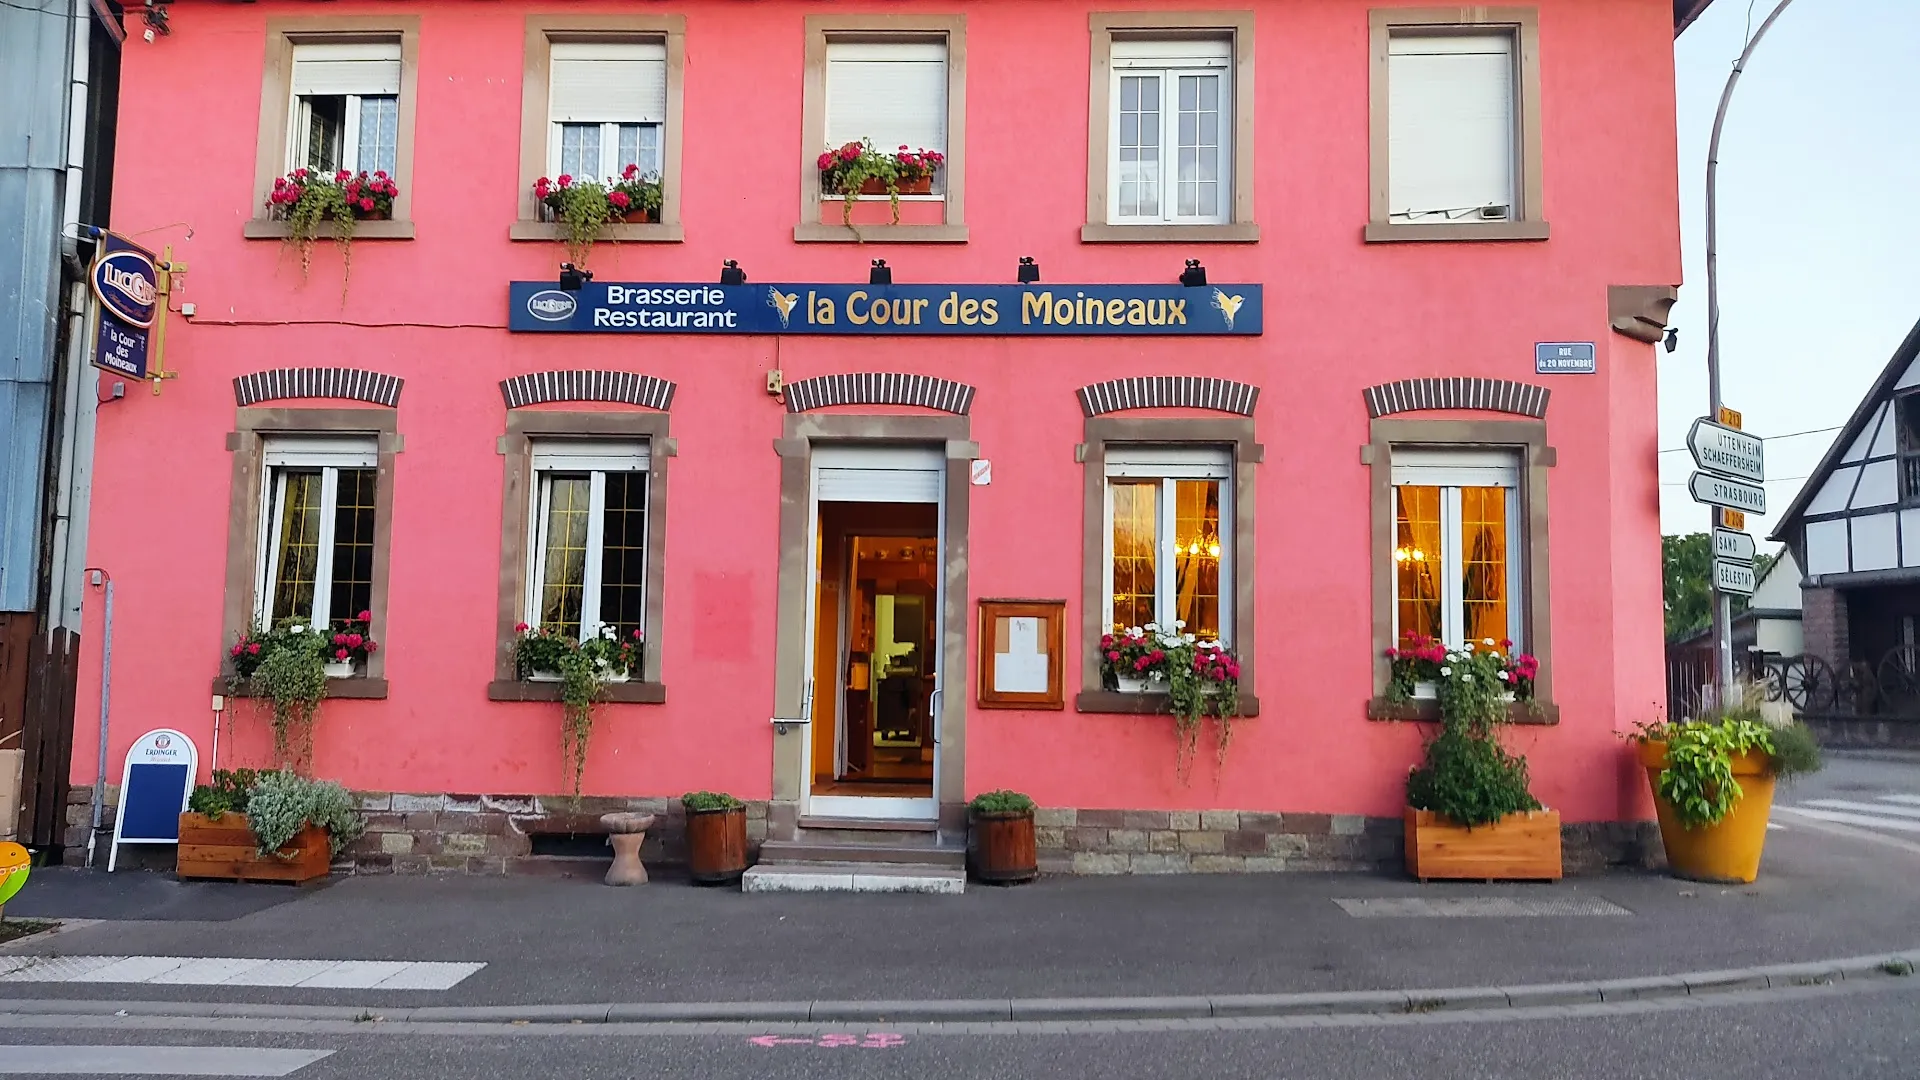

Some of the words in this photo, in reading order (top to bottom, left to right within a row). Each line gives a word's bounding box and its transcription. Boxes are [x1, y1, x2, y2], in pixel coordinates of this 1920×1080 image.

[608, 286, 724, 305] Brasserie
[594, 308, 737, 328] Restaurant
[808, 291, 835, 325] la
[846, 291, 929, 325] Cour
[939, 291, 999, 325] des
[1021, 291, 1187, 326] Moineaux
[110, 328, 118, 342] la
[118, 332, 136, 348] Cour
[115, 344, 129, 358] des
[1558, 347, 1572, 356] RUE
[104, 351, 138, 373] Moineaux
[1547, 359, 1557, 368] 20
[1557, 359, 1593, 368] NOVEMBRE
[1720, 409, 1725, 422] D
[1717, 432, 1760, 458] UTTENHEIM
[1703, 447, 1761, 473] SCHAEFFERSHEIM
[1713, 484, 1763, 506] STRASBOURG
[1719, 536, 1737, 552] SAND
[1720, 566, 1751, 586] SÉLESTAT
[145, 748, 178, 756] ERDINGER
